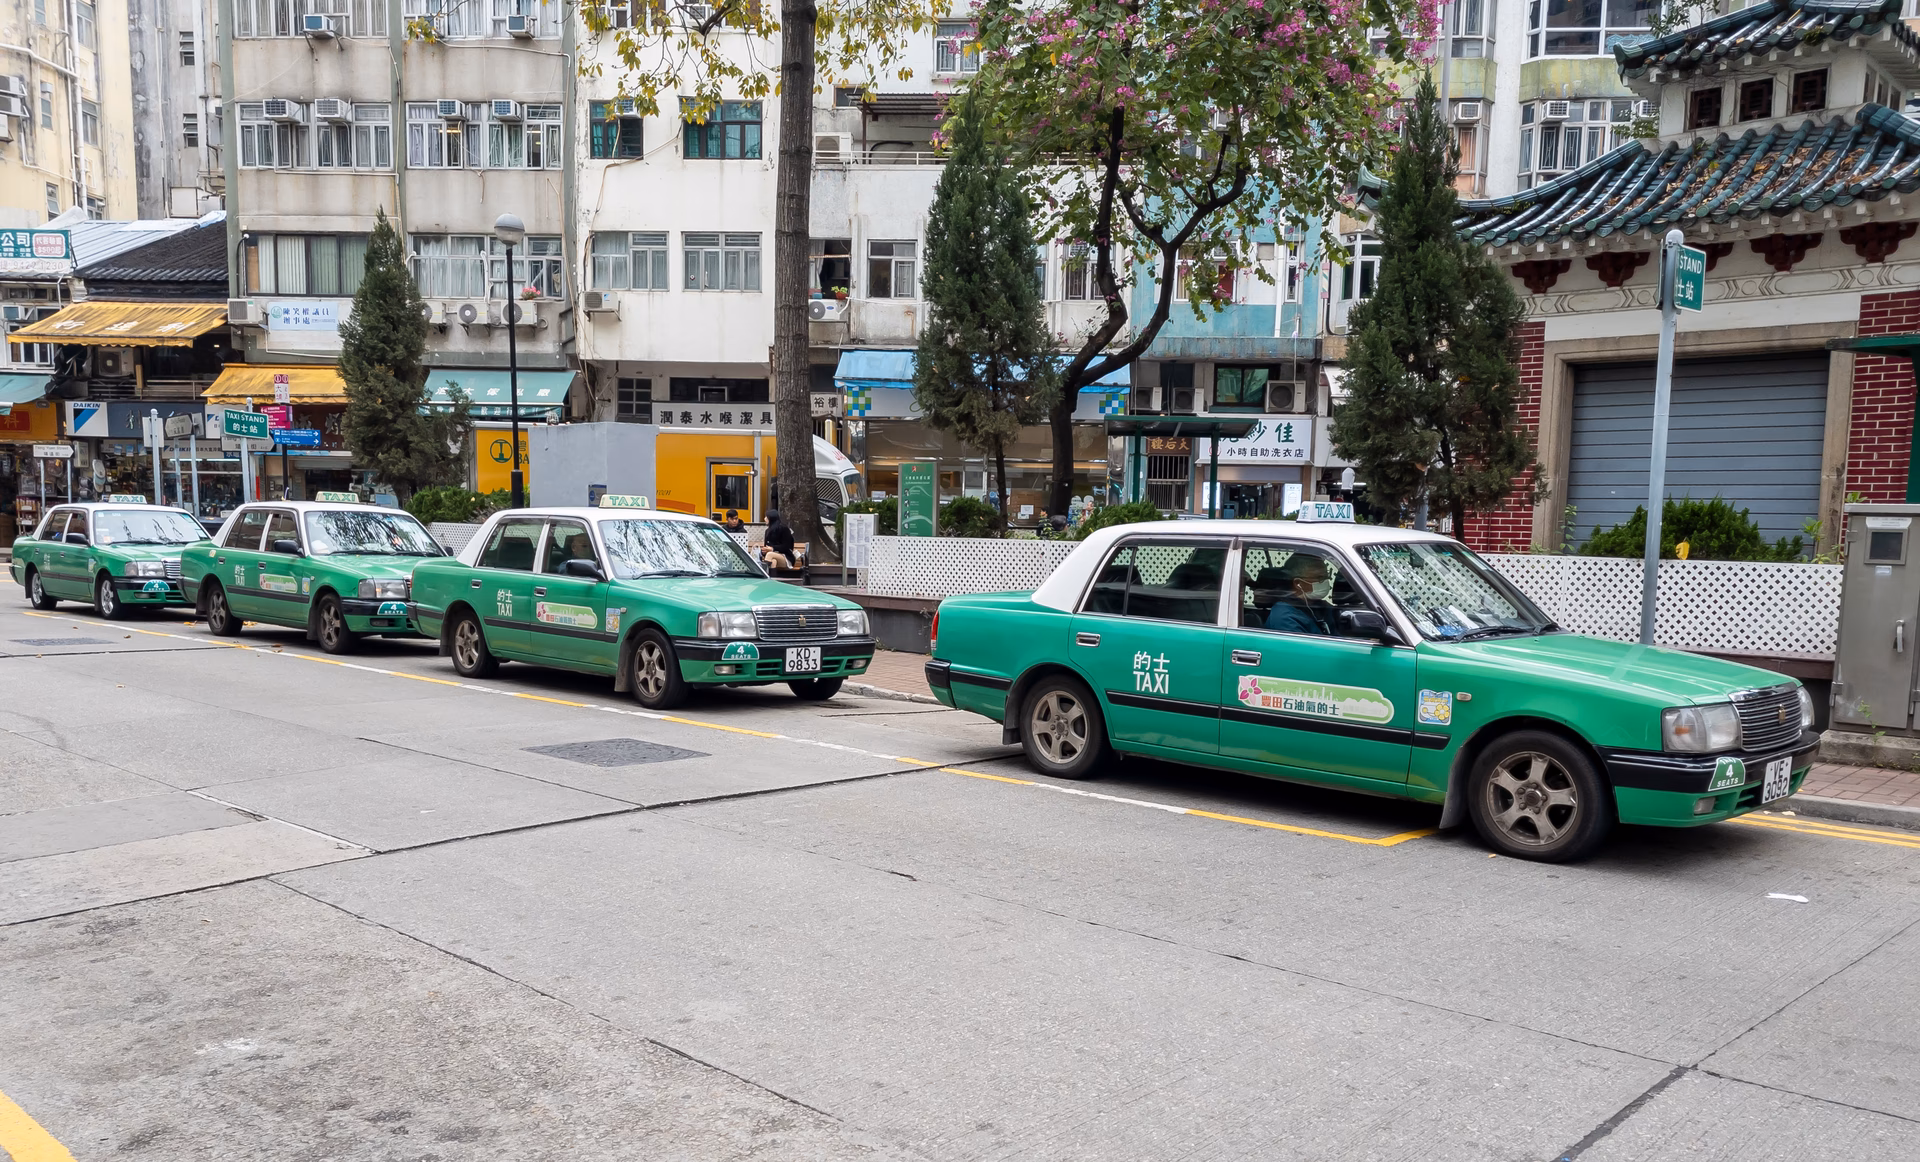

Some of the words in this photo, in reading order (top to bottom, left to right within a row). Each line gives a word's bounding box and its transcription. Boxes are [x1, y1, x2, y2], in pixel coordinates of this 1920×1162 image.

[1, 232, 30, 247] 公司
[1680, 255, 1703, 274] STAND
[1675, 279, 1694, 301] 士站
[225, 411, 240, 420] TAXI
[241, 414, 265, 423] STAND
[660, 411, 773, 425] 潤泰水喉潔具
[232, 422, 258, 433] 的士站
[1226, 447, 1304, 458] 小時自助洗衣店
[113, 495, 144, 503] TAXI
[322, 492, 356, 502] TAXI
[609, 495, 646, 507] TAXI
[1315, 503, 1352, 519] TAXI
[496, 589, 513, 602] 的士
[496, 602, 513, 617] TAXI
[737, 645, 745, 653] 4
[796, 648, 811, 660] KD
[788, 659, 818, 670] 9833
[1133, 650, 1170, 673] 的士
[1133, 670, 1170, 694] TAXI
[1726, 764, 1733, 778] 4
[1774, 760, 1785, 780] VE
[1717, 777, 1739, 787] SEATS
[1764, 776, 1789, 801] 3092
